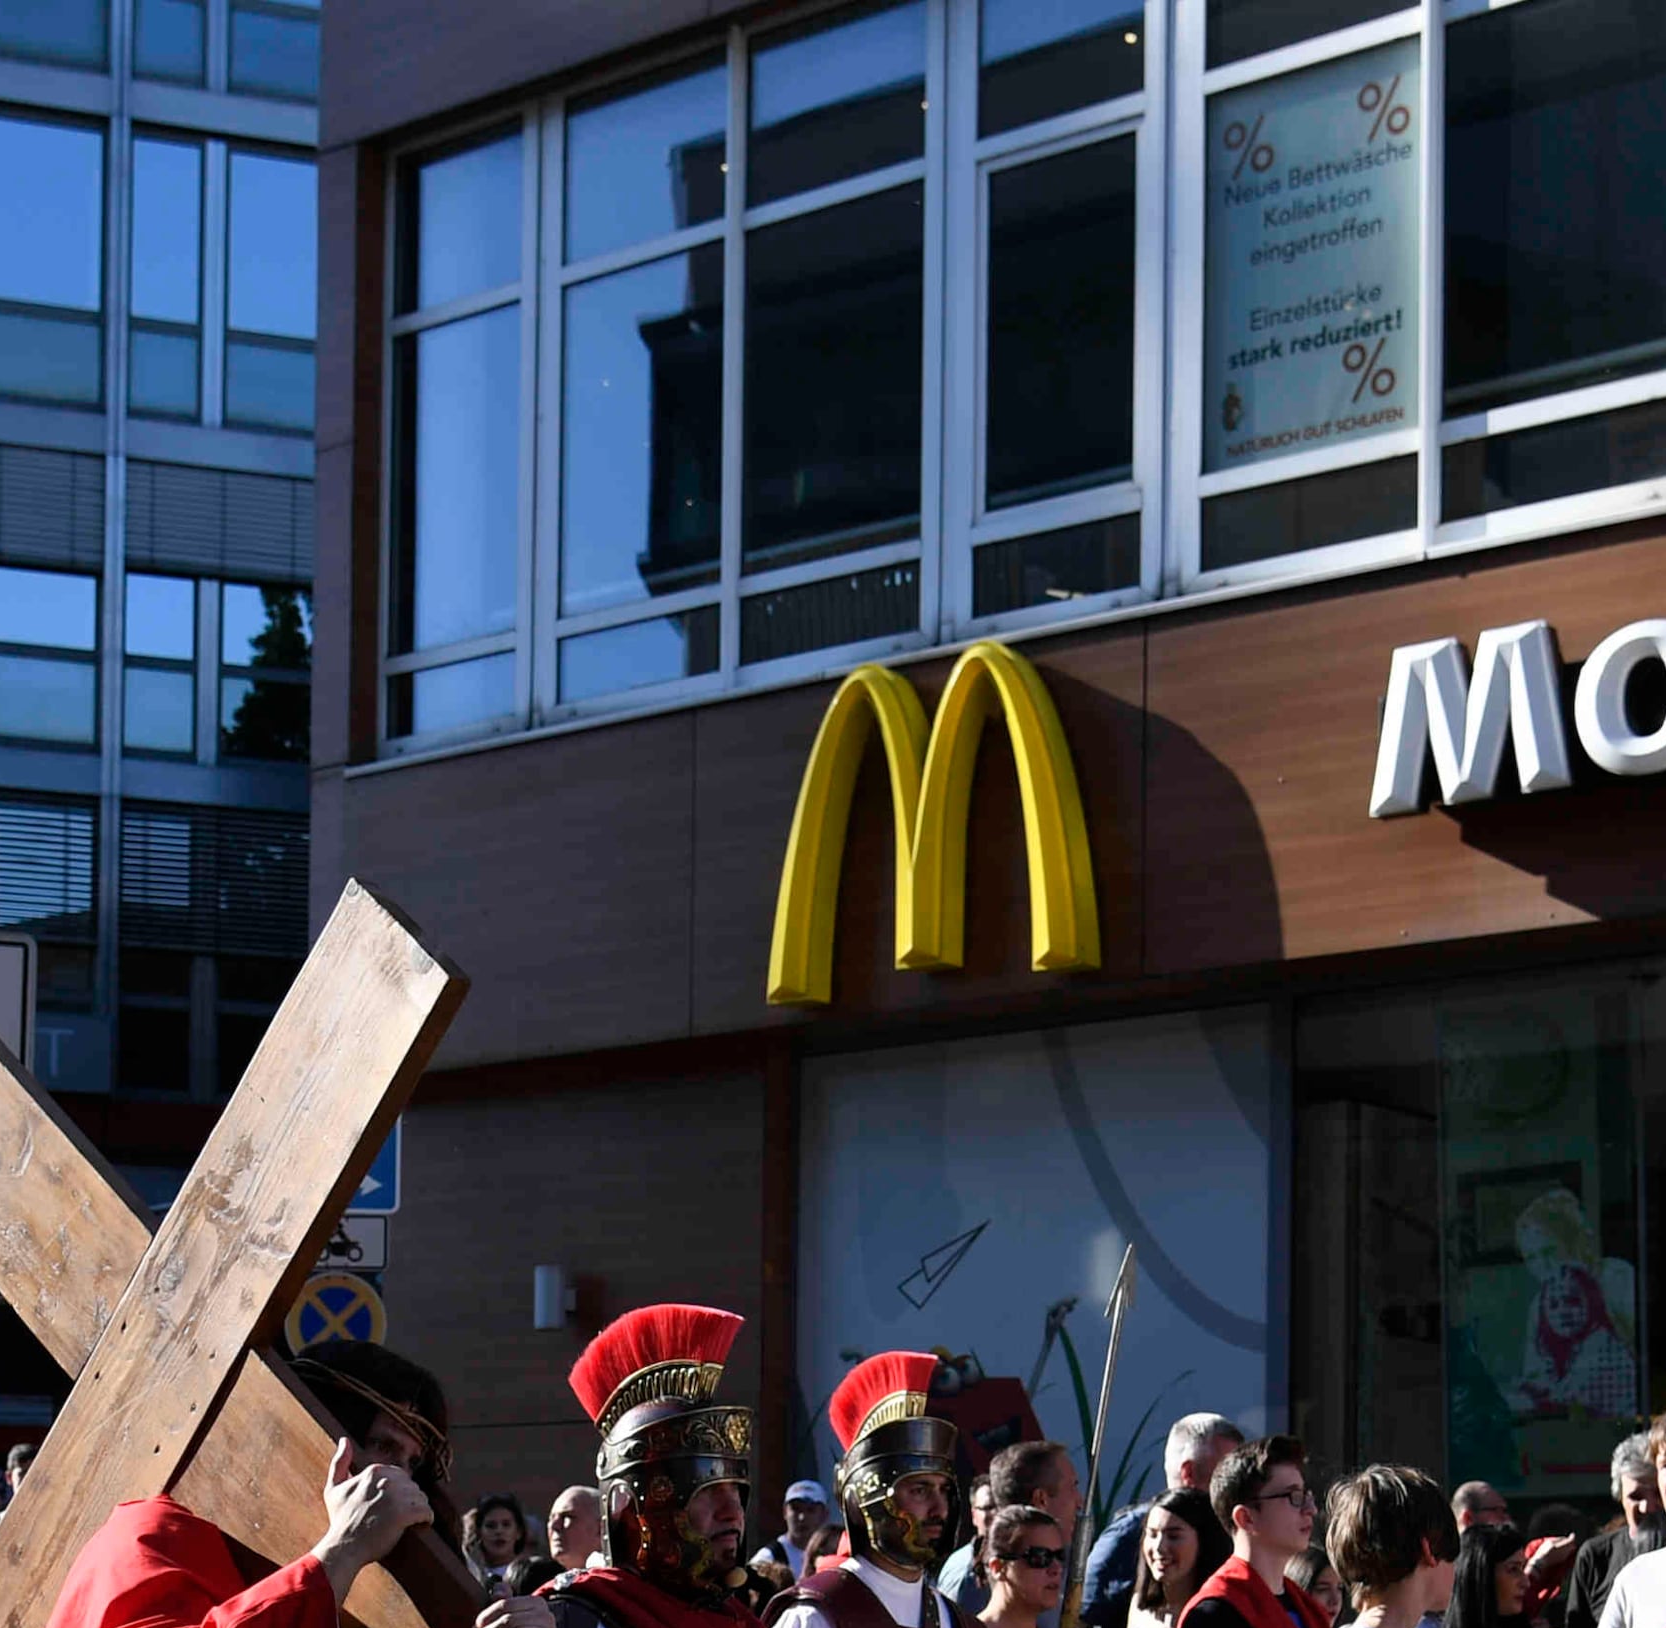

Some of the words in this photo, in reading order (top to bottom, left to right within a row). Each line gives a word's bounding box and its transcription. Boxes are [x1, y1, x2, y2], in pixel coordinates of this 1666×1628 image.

[1223, 176, 1282, 208] Neue
[1288, 140, 1413, 190] Bettwäsche
[1263, 183, 1371, 230] Kollektion
[1249, 216, 1383, 266] eingetroffen
[1249, 283, 1382, 332] Einzelstücke
[1228, 340, 1283, 371] stark
[1290, 310, 1403, 352] reduziert!
[1302, 421, 1332, 441] GUT
[1335, 407, 1404, 434] SCHLAFEN
